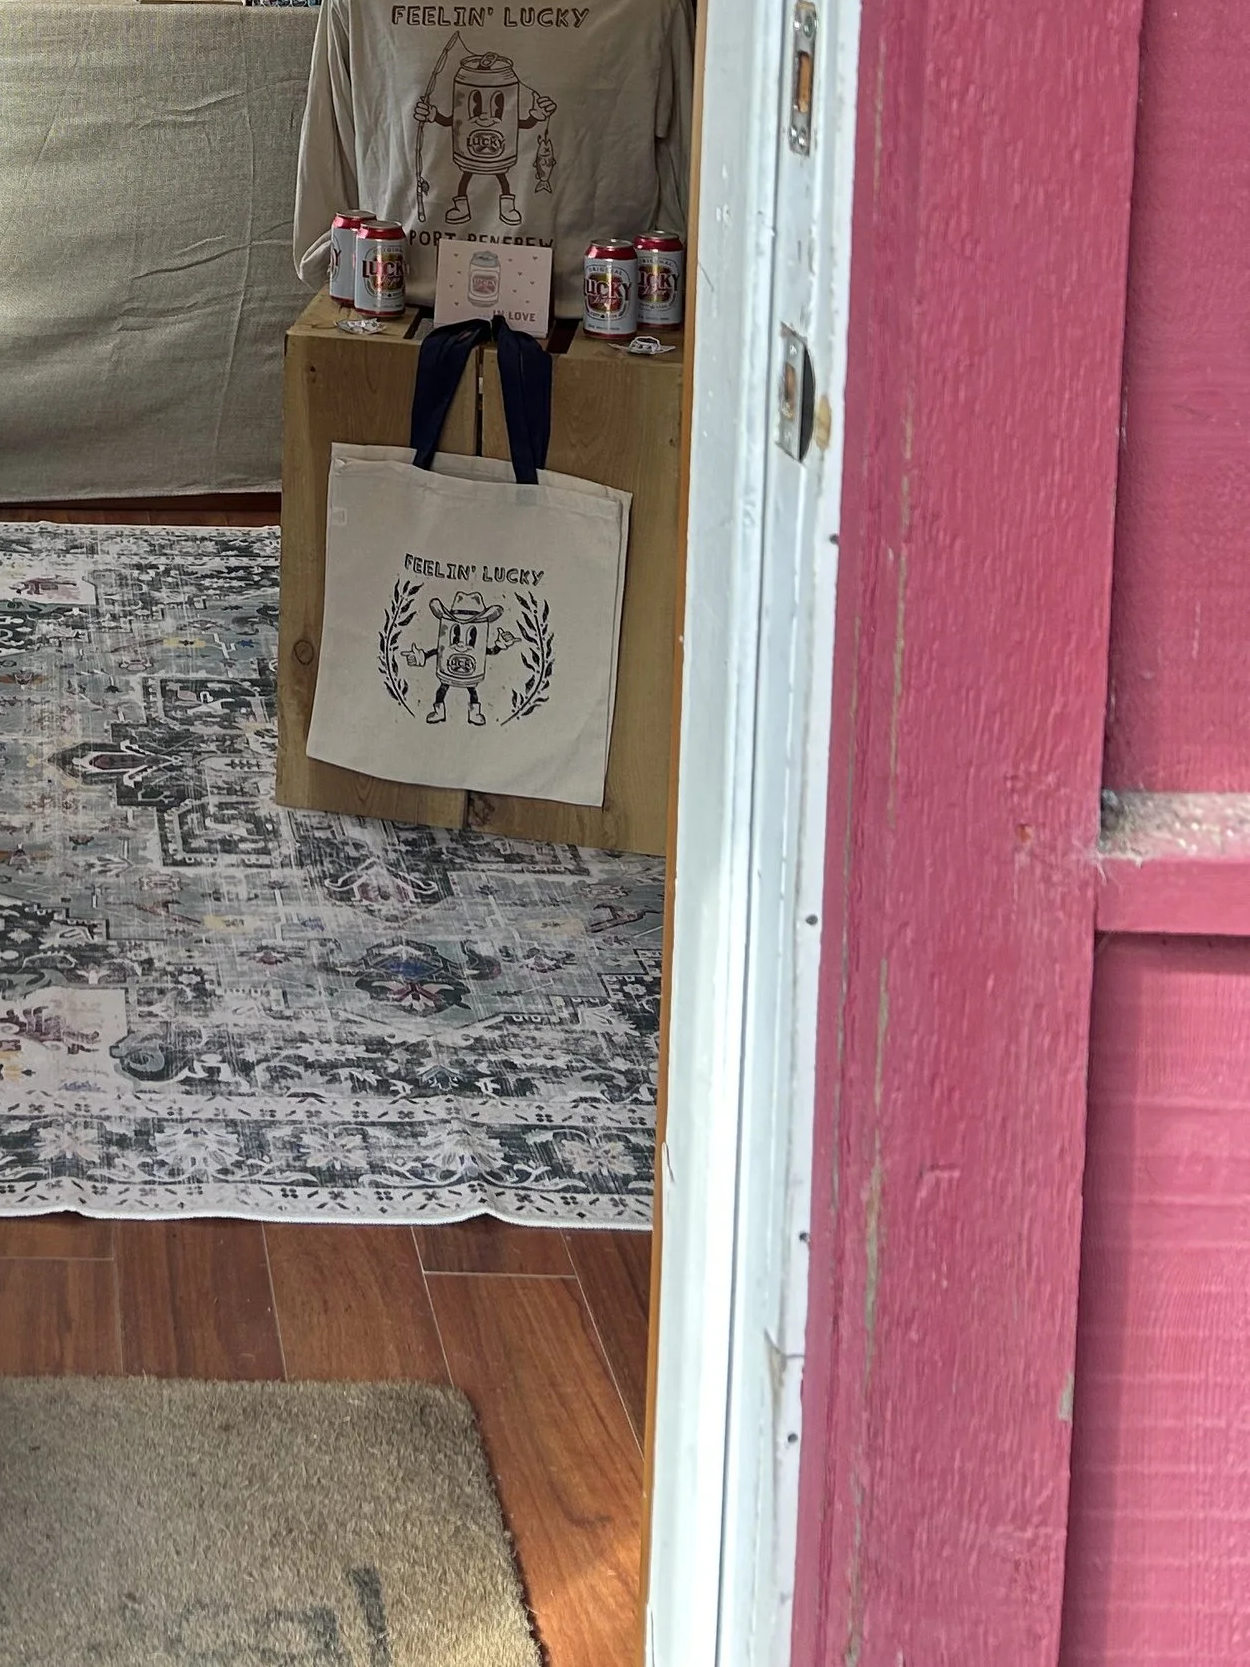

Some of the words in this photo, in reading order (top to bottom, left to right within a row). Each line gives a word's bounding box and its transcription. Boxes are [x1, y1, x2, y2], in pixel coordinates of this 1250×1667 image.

[391, 5, 494, 28] FEELIN'
[503, 6, 590, 28] LUCKY
[466, 135, 506, 149] LUCKY
[507, 310, 536, 322] LOVE
[404, 552, 476, 581] FEELIN'
[482, 565, 545, 586] LUCKY
